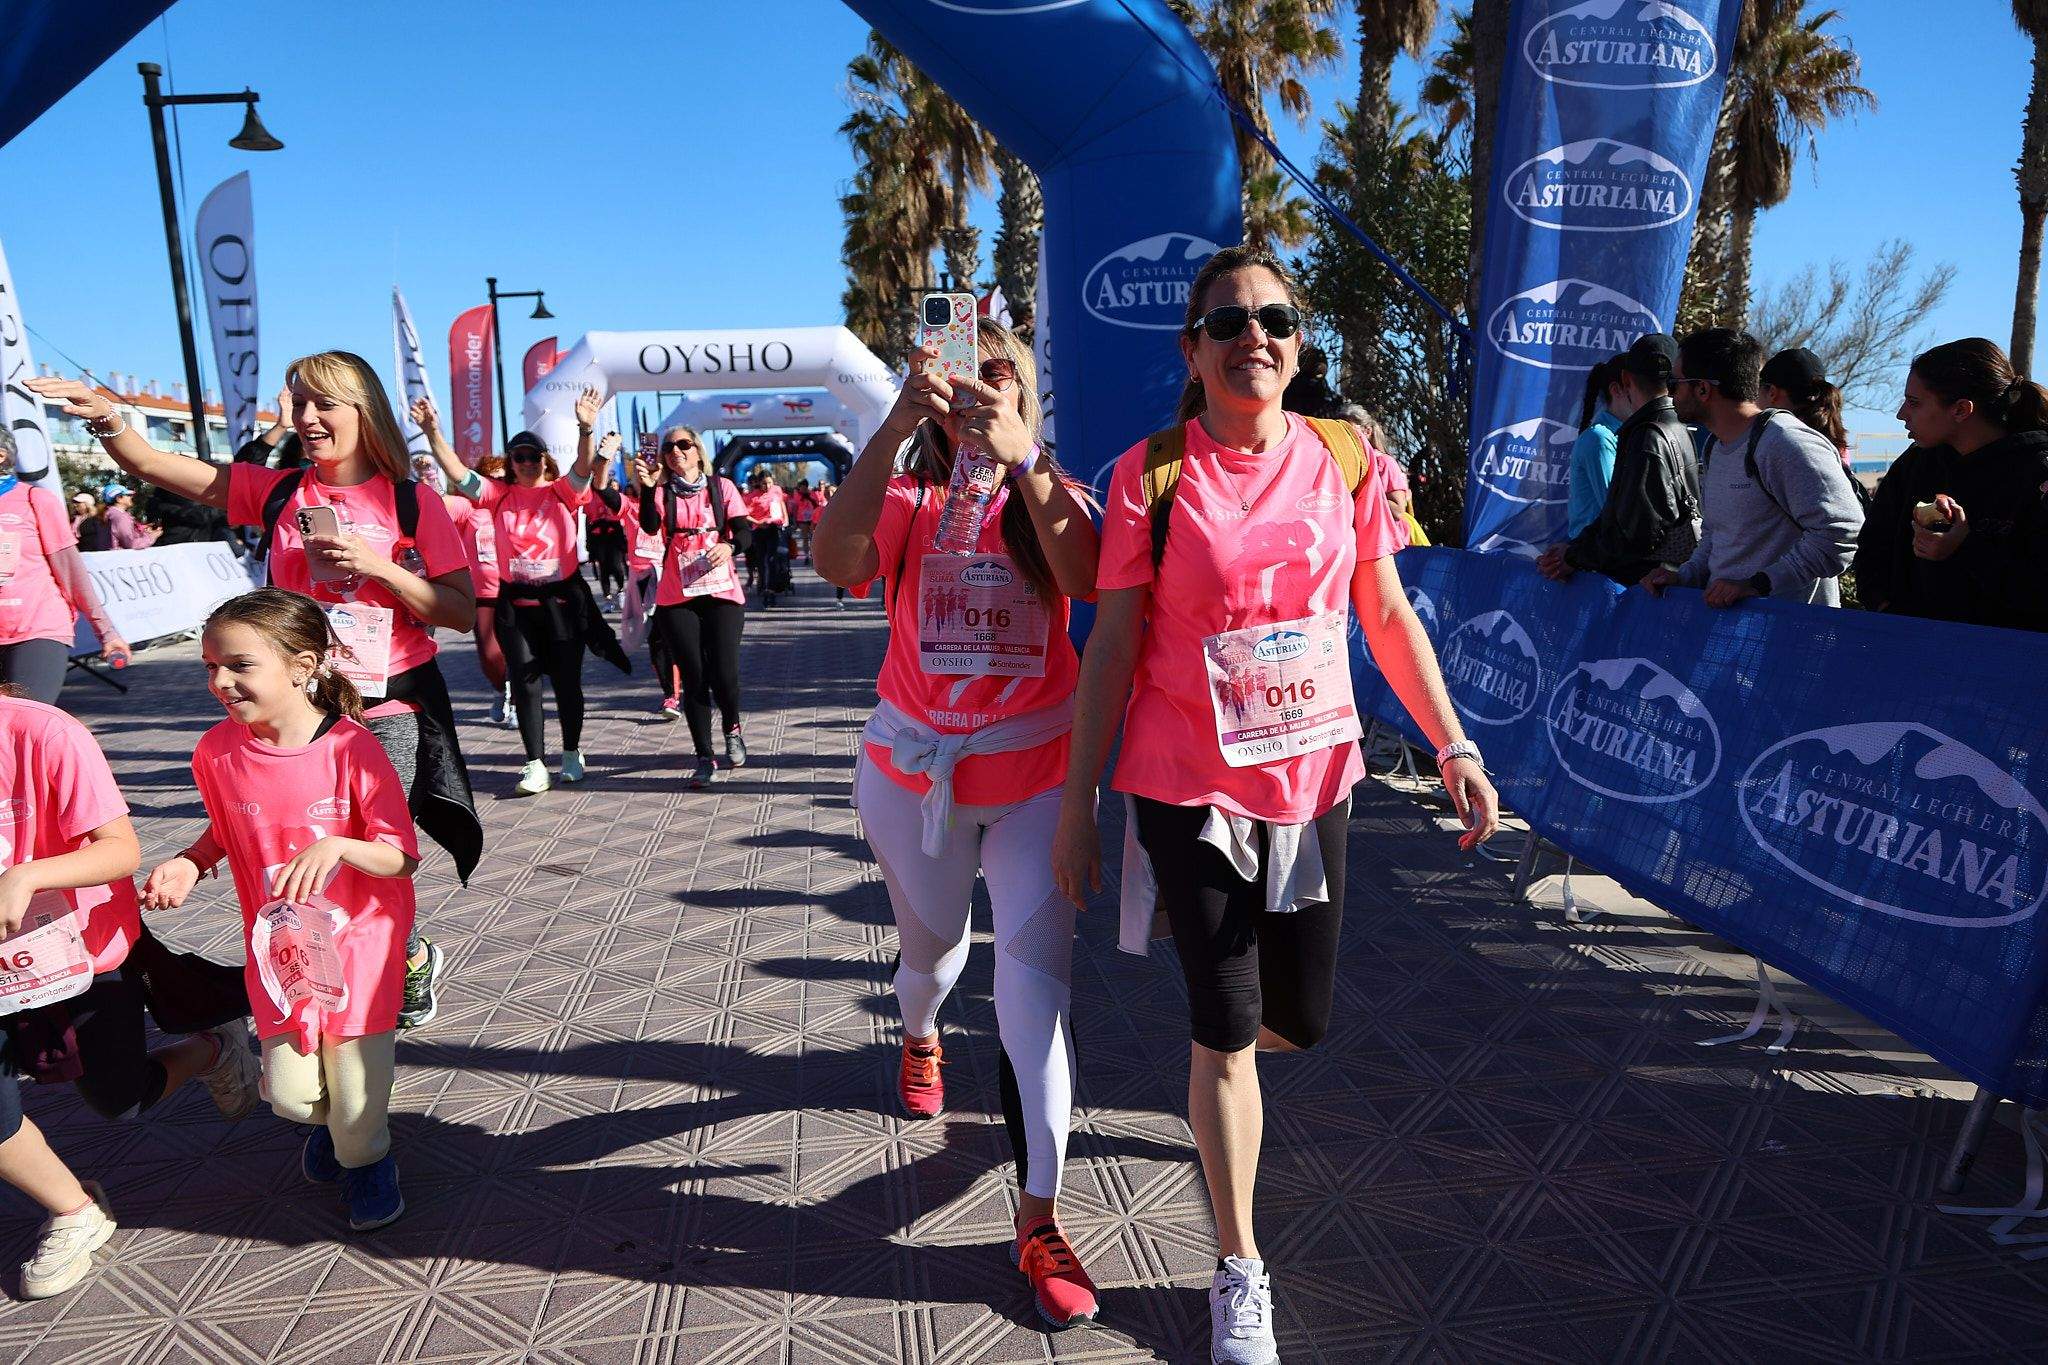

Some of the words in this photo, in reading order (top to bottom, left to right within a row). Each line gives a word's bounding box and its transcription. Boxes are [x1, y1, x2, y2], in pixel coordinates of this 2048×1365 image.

[1570, 26, 1633, 37] CENTRAL
[1640, 29, 1702, 46] LECHERA
[1535, 30, 1703, 76] ASTURIANA
[1546, 170, 1605, 180] CENTRAL
[1611, 172, 1676, 187] LECHERA
[1516, 173, 1678, 215] ASTURIANA
[1122, 266, 1185, 278] CENTRAL
[1095, 273, 1190, 309] ASTUR
[1527, 308, 1576, 319] CENTRAL
[209, 234, 259, 441] YSHO
[639, 341, 793, 375] OYSHO
[465, 332, 483, 420] Santander
[749, 440, 815, 449] VOLVO
[1479, 444, 1571, 485] ASTURI
[963, 570, 1010, 583] ASTURIANA
[964, 607, 1011, 628] 016
[974, 632, 996, 641] 1668
[1258, 641, 1307, 657] ASTURIANA
[932, 657, 973, 667] OYSHO
[997, 660, 1032, 670] Santander
[1265, 678, 1316, 708] 016
[924, 710, 968, 727] RRERA
[1279, 708, 1303, 721] 1669
[1237, 729, 1268, 740] CARRERA
[1269, 726, 1279, 734] DE
[1280, 724, 1289, 733] LA
[1289, 720, 1310, 731] MUJER
[1552, 686, 1697, 786] ATURIANA
[1238, 741, 1283, 756] OYSHO
[1811, 763, 1901, 804] CENTRAL
[1911, 793, 2030, 844] LECHERA
[1750, 758, 2022, 910] ASTURIANA
[31, 982, 77, 1001] Santander
